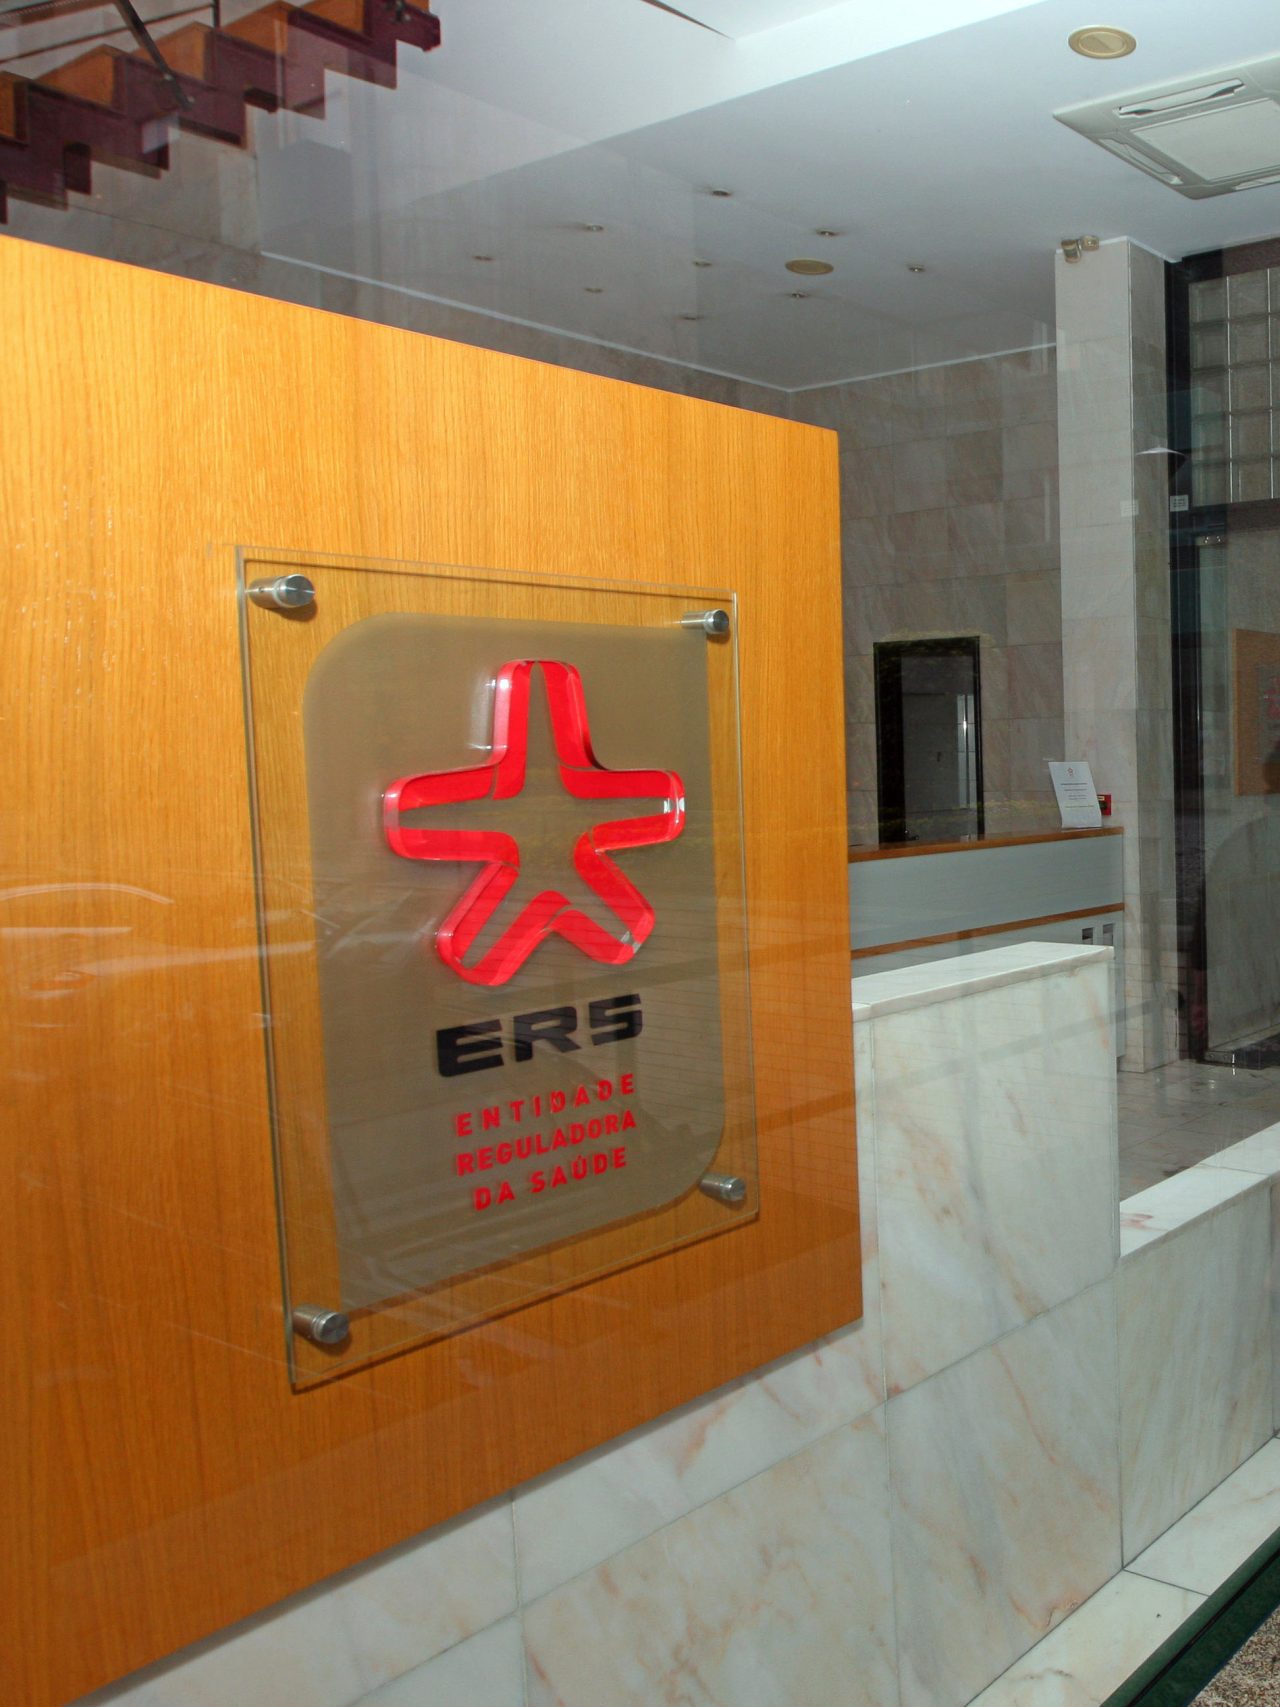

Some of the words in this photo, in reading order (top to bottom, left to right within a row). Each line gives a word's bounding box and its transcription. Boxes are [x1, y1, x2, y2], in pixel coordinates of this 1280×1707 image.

[436, 993, 643, 1077] ERS
[455, 1073, 635, 1137] ENTIDADE
[456, 1109, 637, 1177] REGULADORA
[473, 1181, 516, 1211] DA
[530, 1146, 627, 1193] SAÚDE
